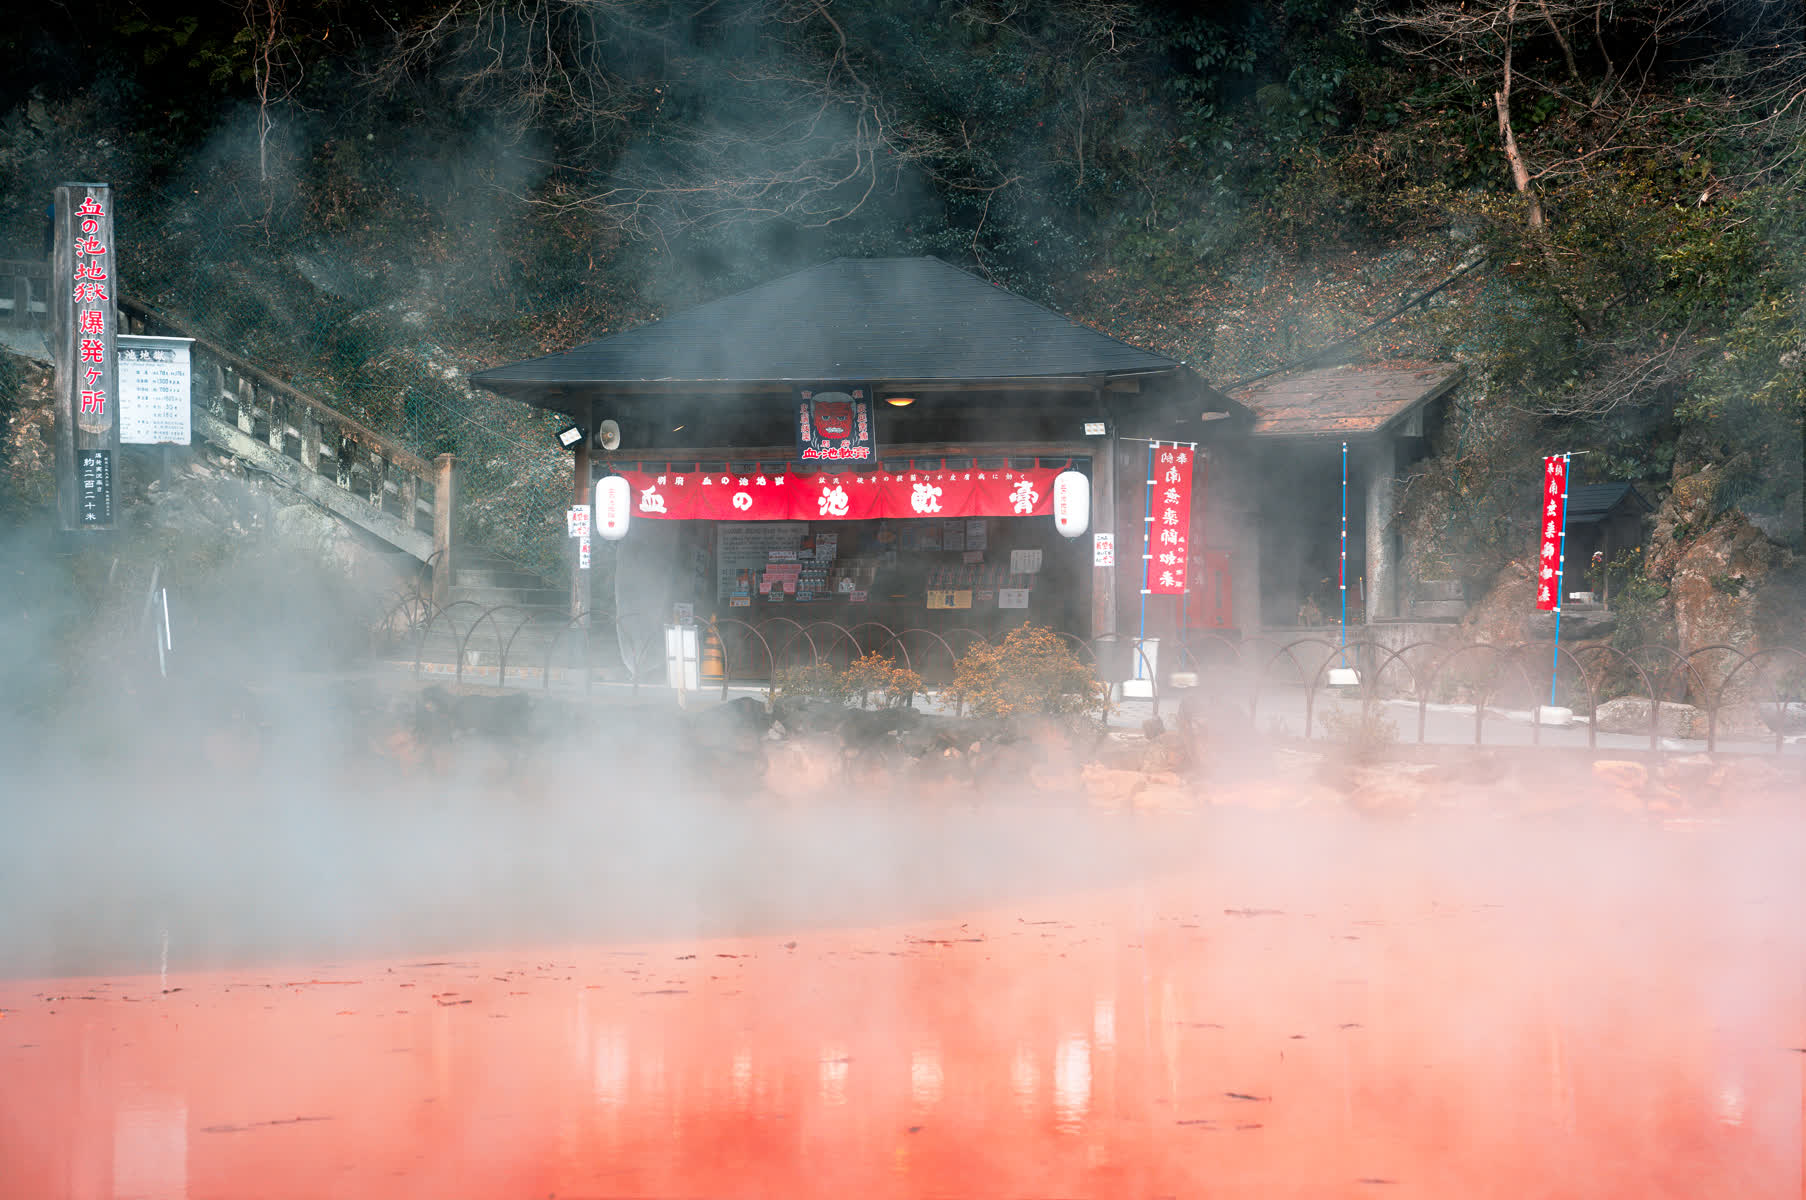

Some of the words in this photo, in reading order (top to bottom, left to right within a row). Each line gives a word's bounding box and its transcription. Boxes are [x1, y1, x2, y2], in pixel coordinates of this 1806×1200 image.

[73, 197, 109, 303] 血の池地獄
[83, 458, 96, 520] 約二百二十米
[639, 480, 1039, 516] 血の池軟膏
